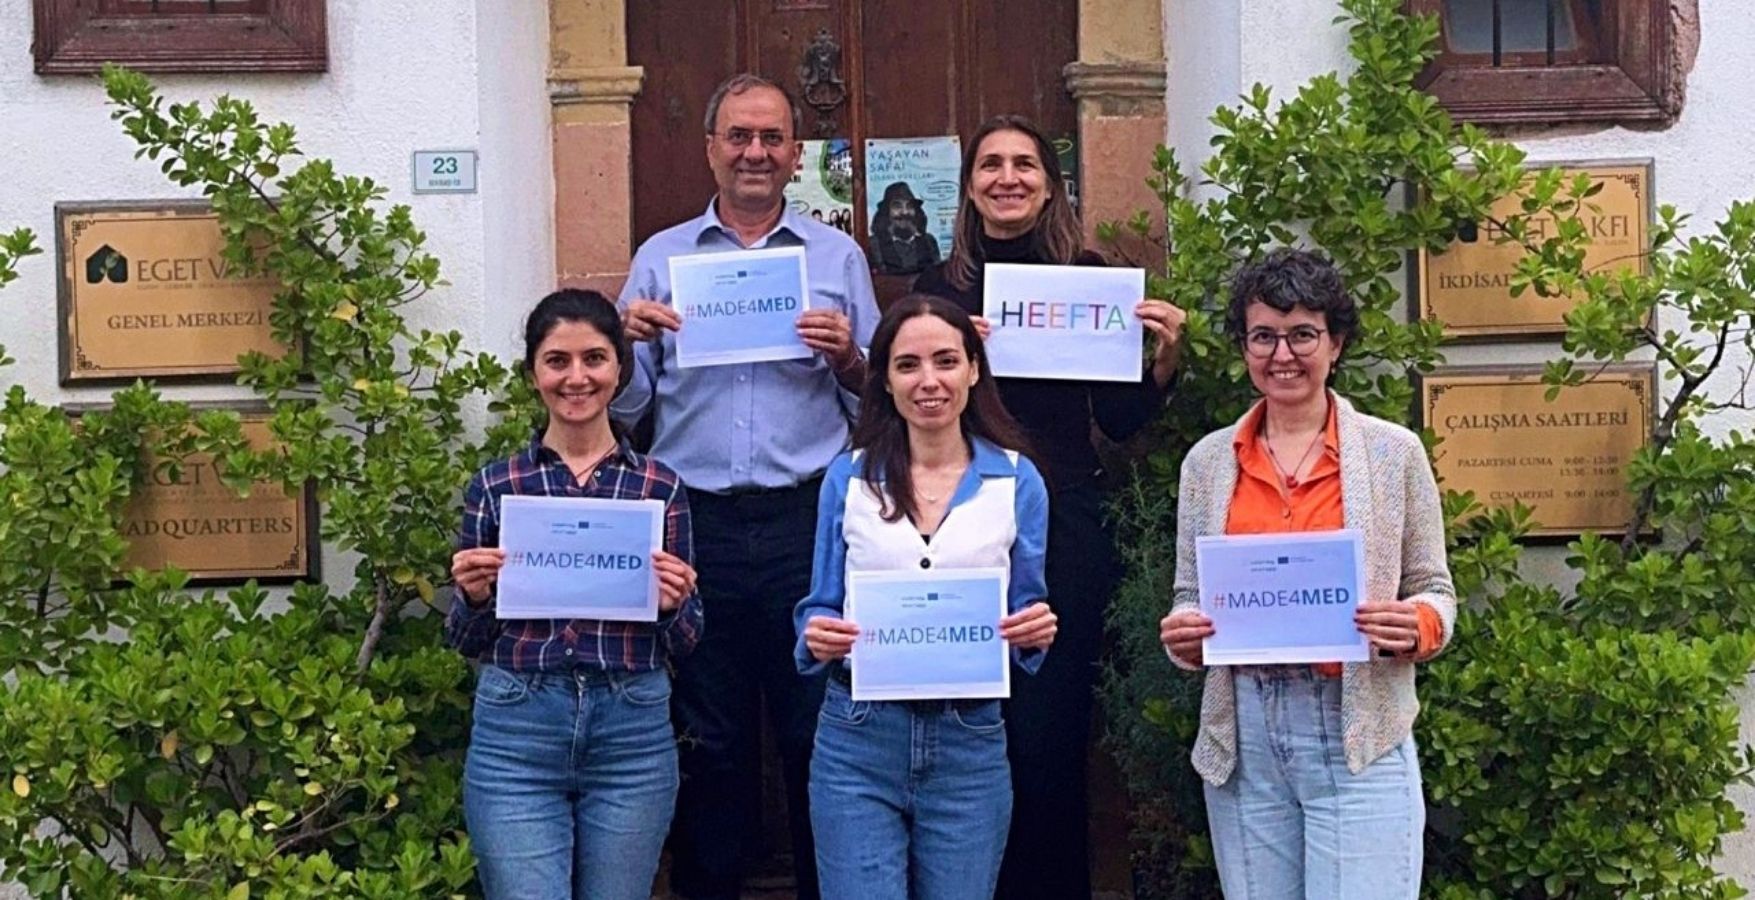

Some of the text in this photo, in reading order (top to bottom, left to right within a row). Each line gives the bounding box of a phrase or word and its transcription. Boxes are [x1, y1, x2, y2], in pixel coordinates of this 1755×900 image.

[433, 157, 458, 174] 23
[137, 258, 203, 282] EGET
[685, 296, 797, 319] #MADE4MED
[1001, 301, 1126, 331] HEEFTA
[107, 310, 263, 330] GENEL MERKEZİ
[1445, 408, 1629, 433] ÇALIŞMA SAATLERİ
[1457, 455, 1516, 468] PAZARTESİ
[1519, 456, 1553, 467] CUMA
[512, 552, 642, 570] #MADE4MED
[1213, 587, 1350, 608] #MADE4MED
[864, 625, 994, 645] #MADE4MED
